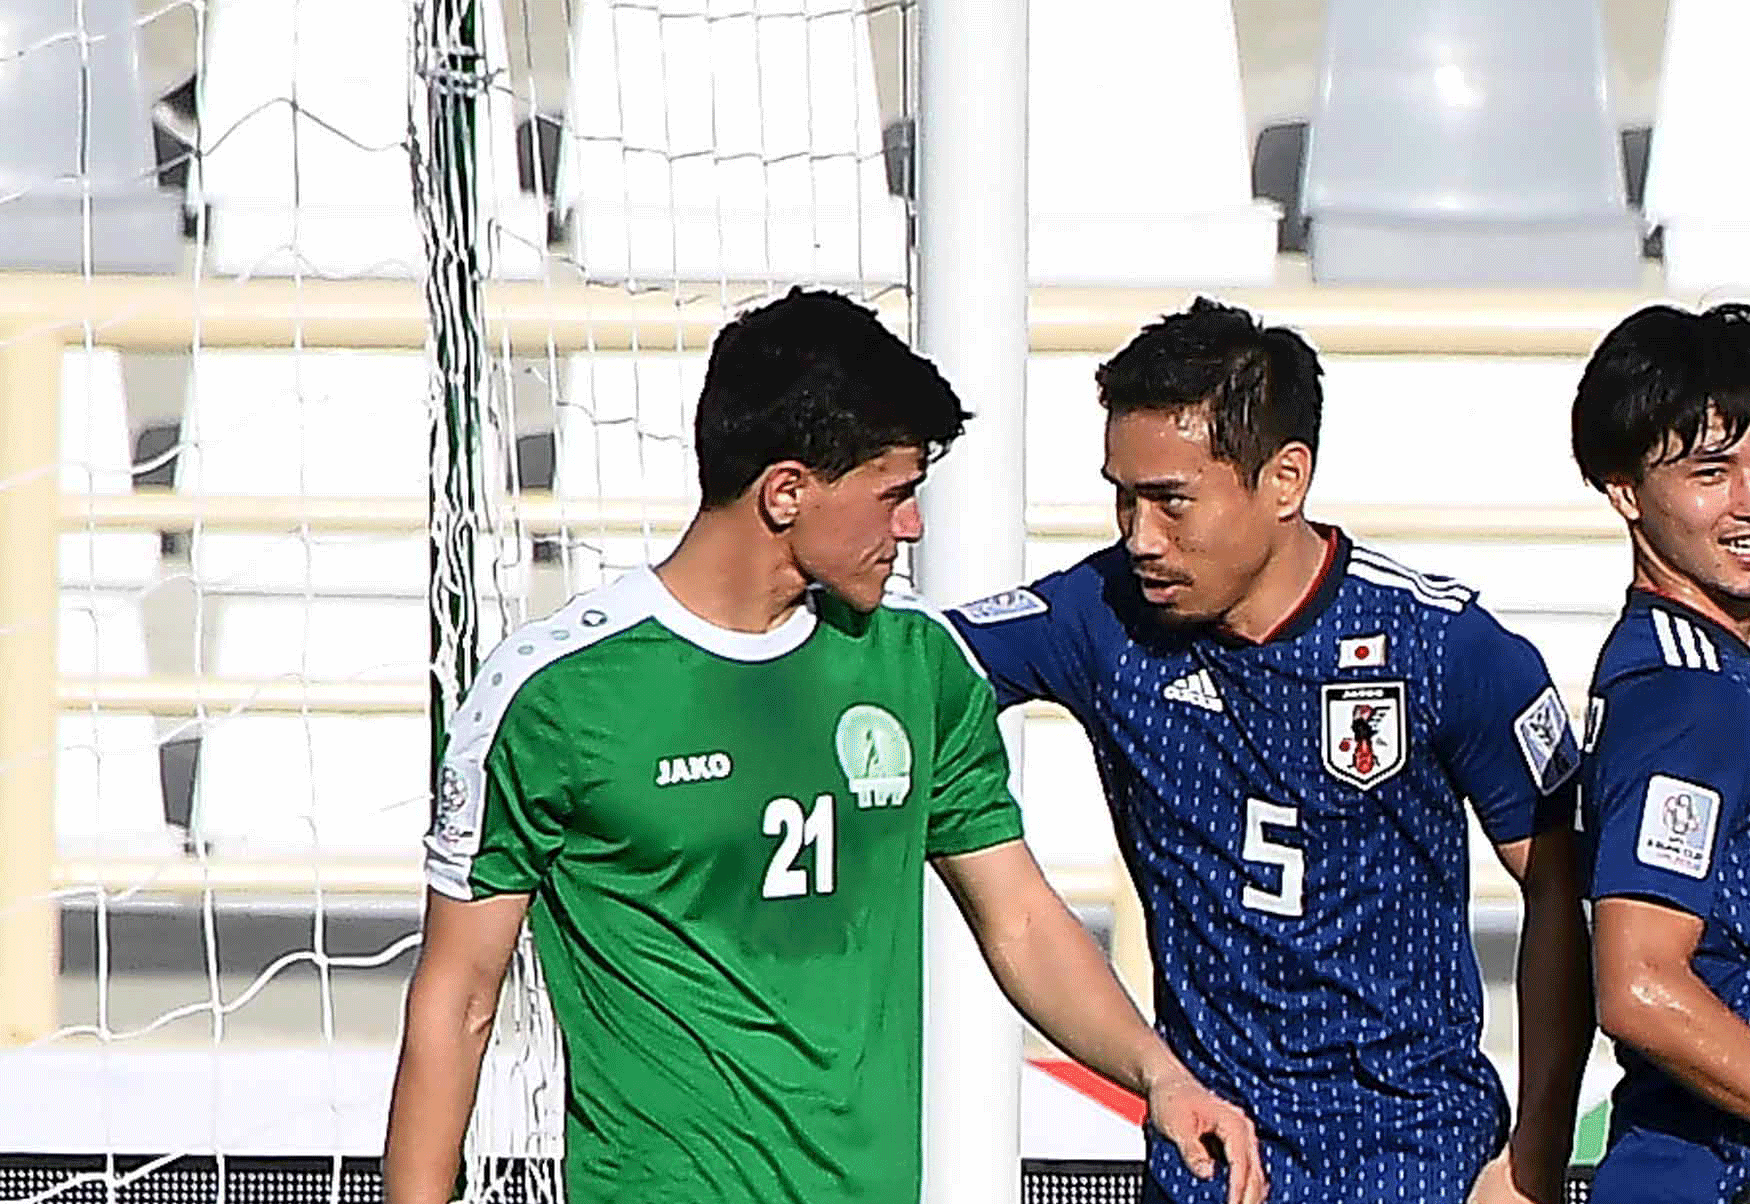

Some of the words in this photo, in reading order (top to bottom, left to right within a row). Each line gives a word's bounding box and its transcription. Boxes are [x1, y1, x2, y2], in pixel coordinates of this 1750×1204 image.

[655, 752, 731, 786] JAKO
[762, 794, 833, 898] 21
[1242, 797, 1305, 917] 5
